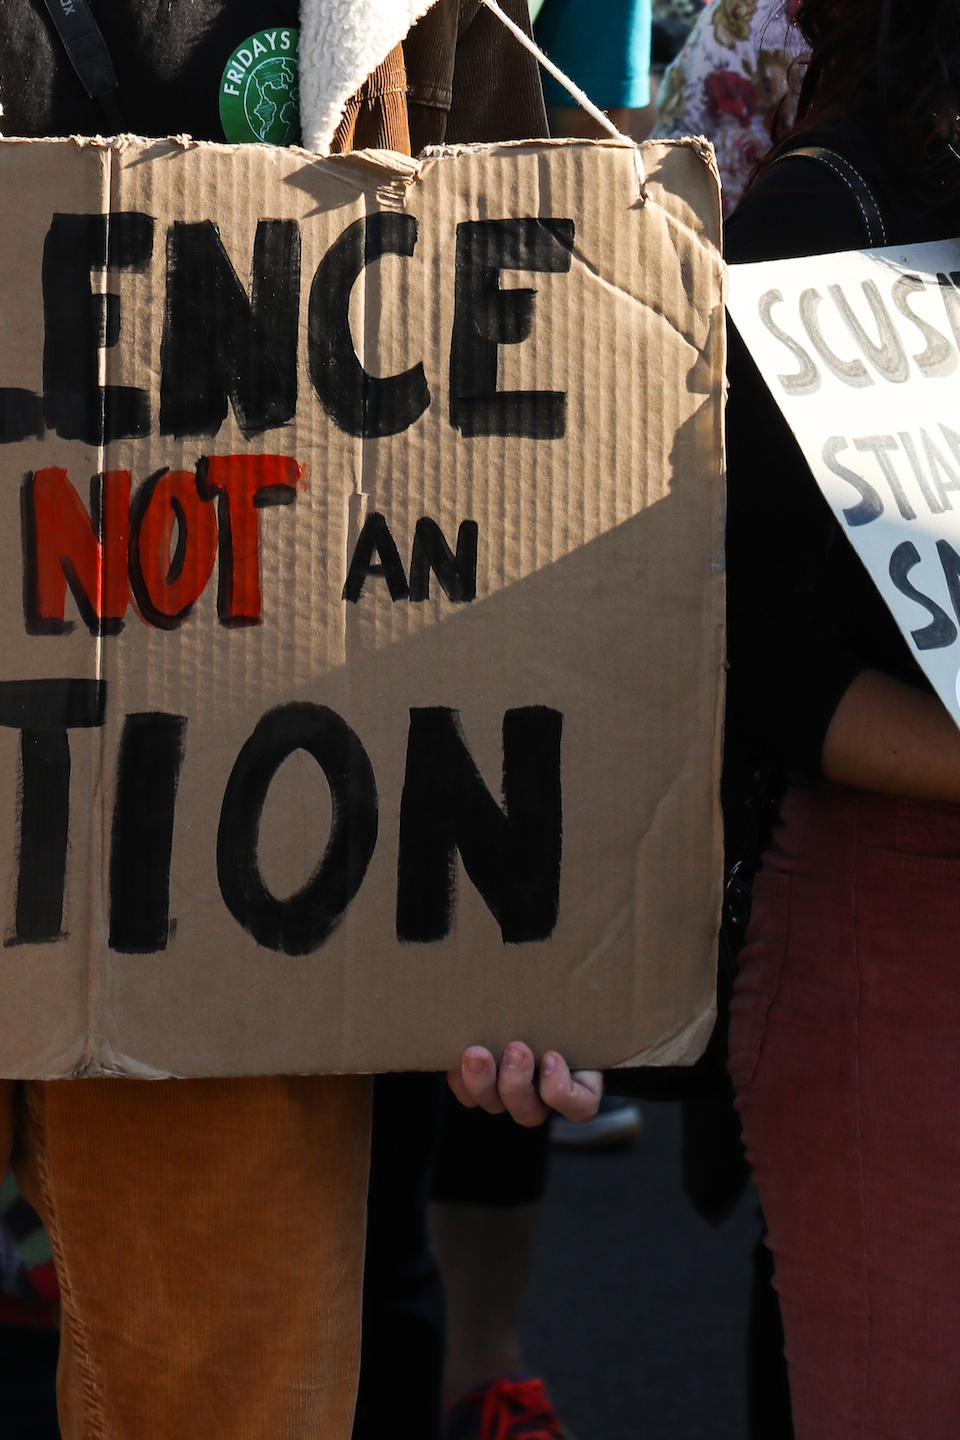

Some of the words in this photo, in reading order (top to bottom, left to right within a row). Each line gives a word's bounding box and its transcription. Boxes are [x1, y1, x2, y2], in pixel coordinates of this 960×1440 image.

[224, 31, 291, 97] FRIDAYS
[21, 453, 304, 637] NOT
[344, 511, 479, 603] AN
